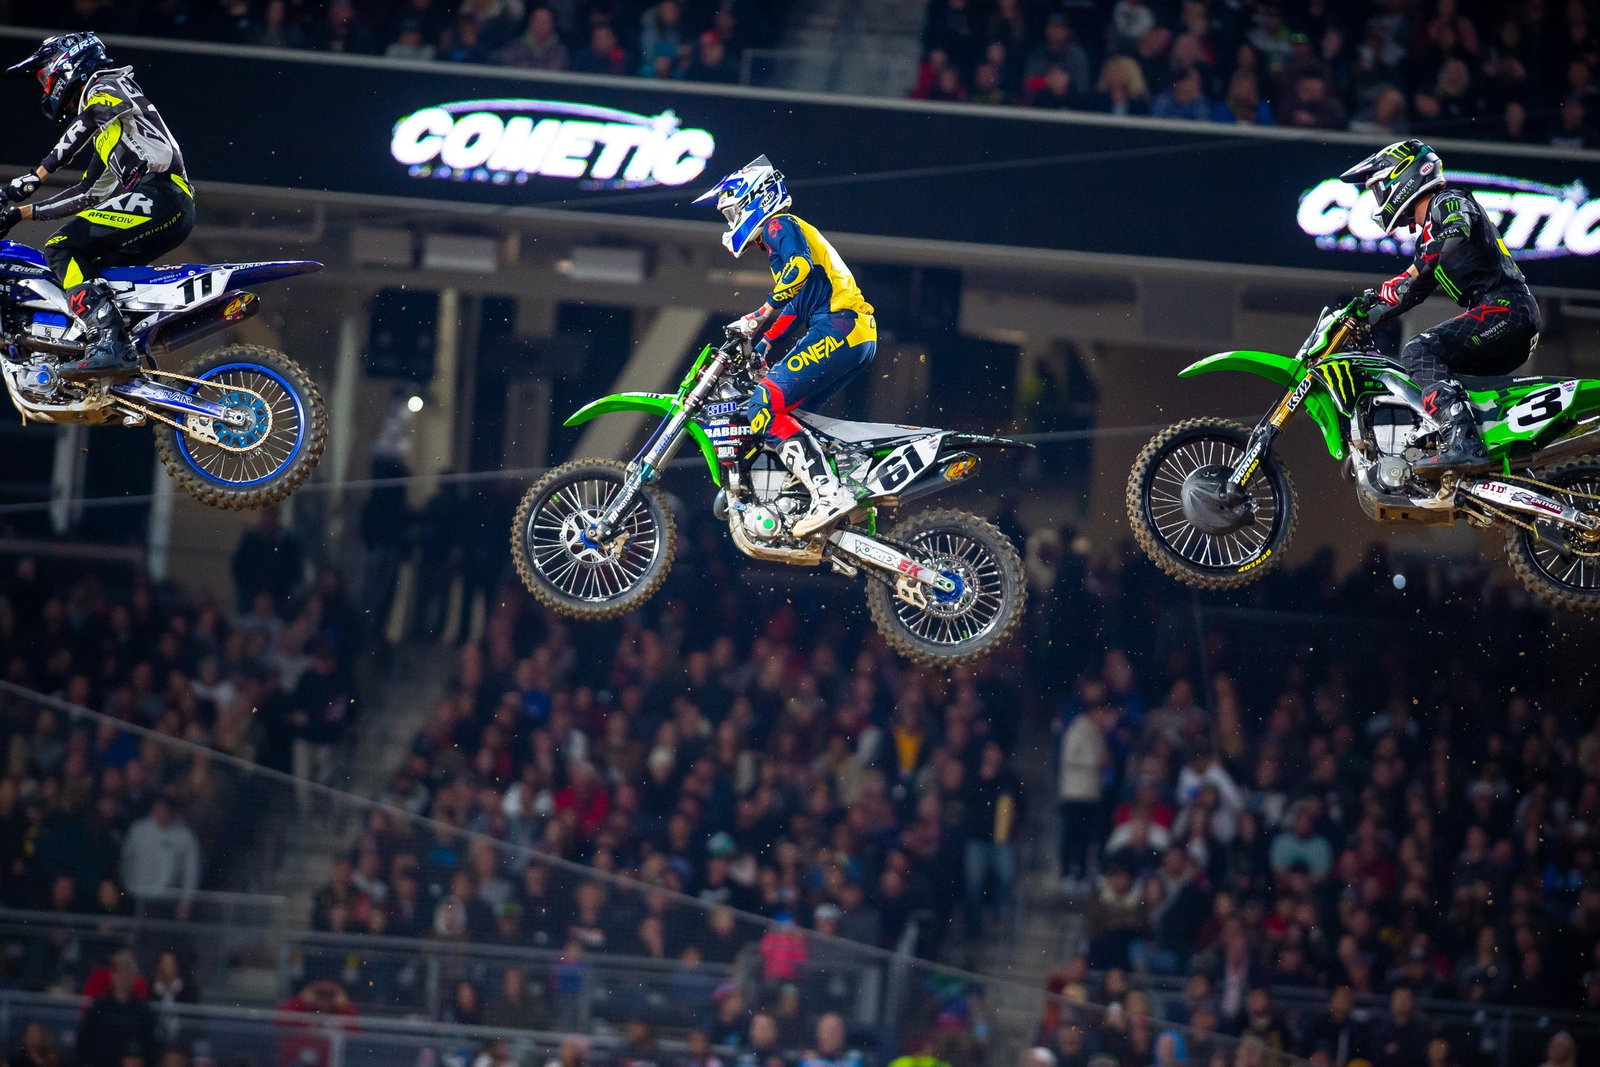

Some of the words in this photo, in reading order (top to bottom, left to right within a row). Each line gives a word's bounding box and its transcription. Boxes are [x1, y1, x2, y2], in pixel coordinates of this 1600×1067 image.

[391, 106, 715, 186] COMETIC
[1421, 163, 1433, 174] BELL
[1392, 178, 1415, 205] MONSTER
[177, 273, 213, 306] 11
[1286, 378, 1312, 412] KYB
[1515, 387, 1563, 427] 3
[876, 445, 925, 491] 61
[1233, 441, 1262, 484] DUNLOP
[1237, 548, 1272, 573] DUNLOP
